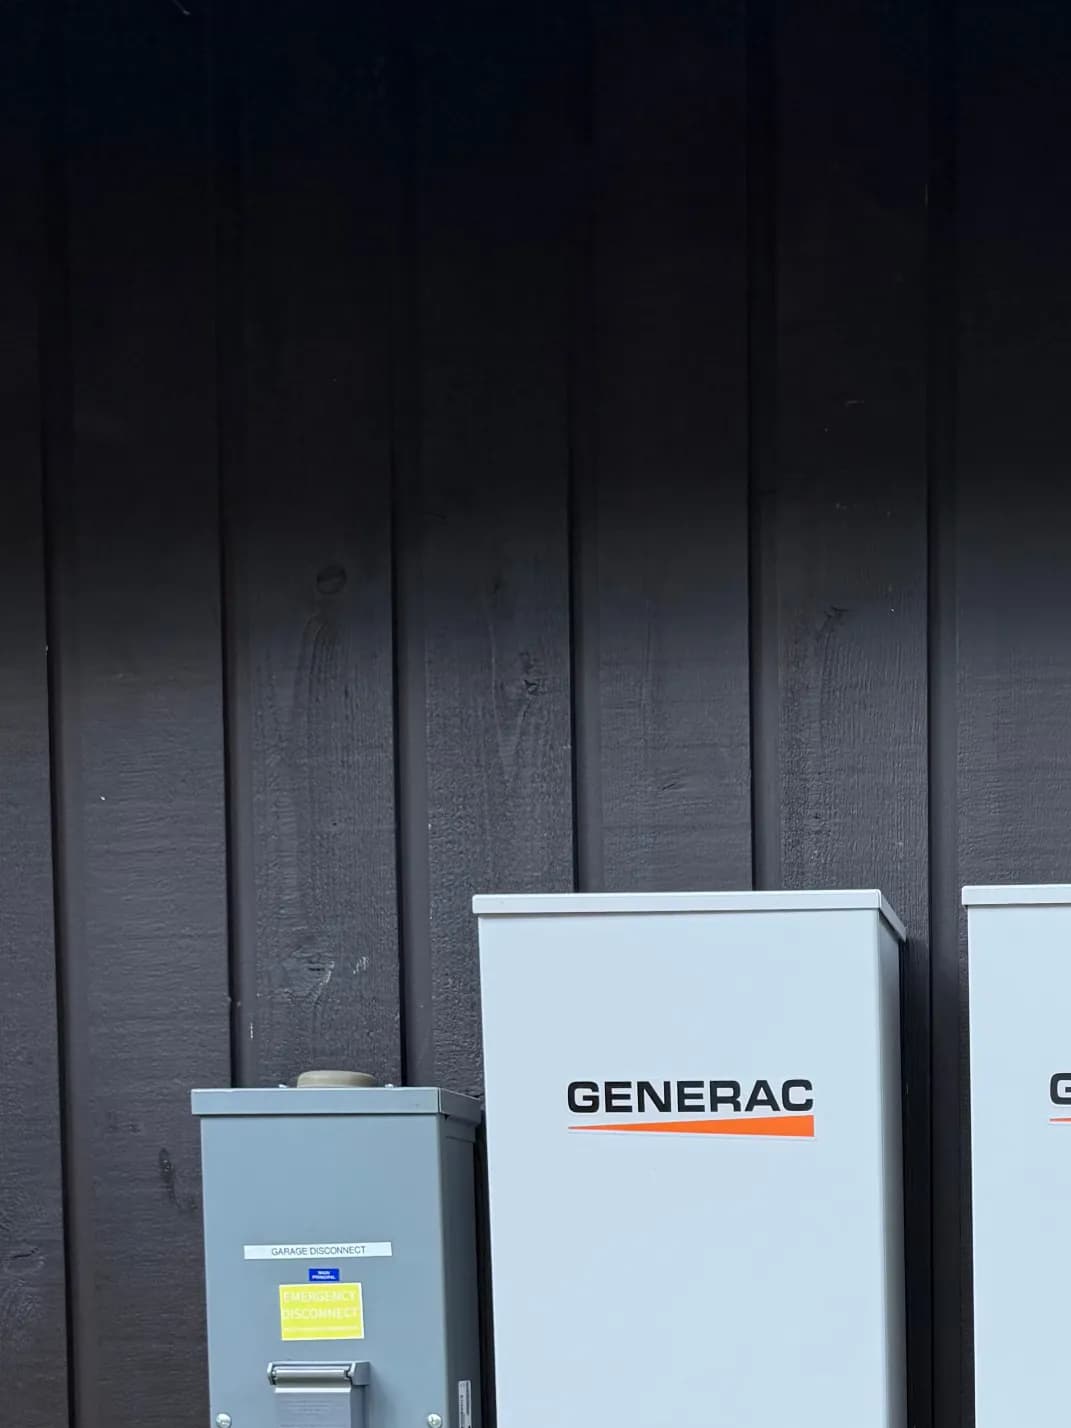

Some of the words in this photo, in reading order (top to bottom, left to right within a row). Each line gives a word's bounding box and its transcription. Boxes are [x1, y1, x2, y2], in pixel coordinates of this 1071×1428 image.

[567, 1079, 813, 1113] GENERAC
[271, 1247, 308, 1256] GARAGE
[310, 1245, 366, 1256] DISCONNECT
[283, 1291, 355, 1303] EMERGENCY
[282, 1307, 358, 1320] DISCONNECT
